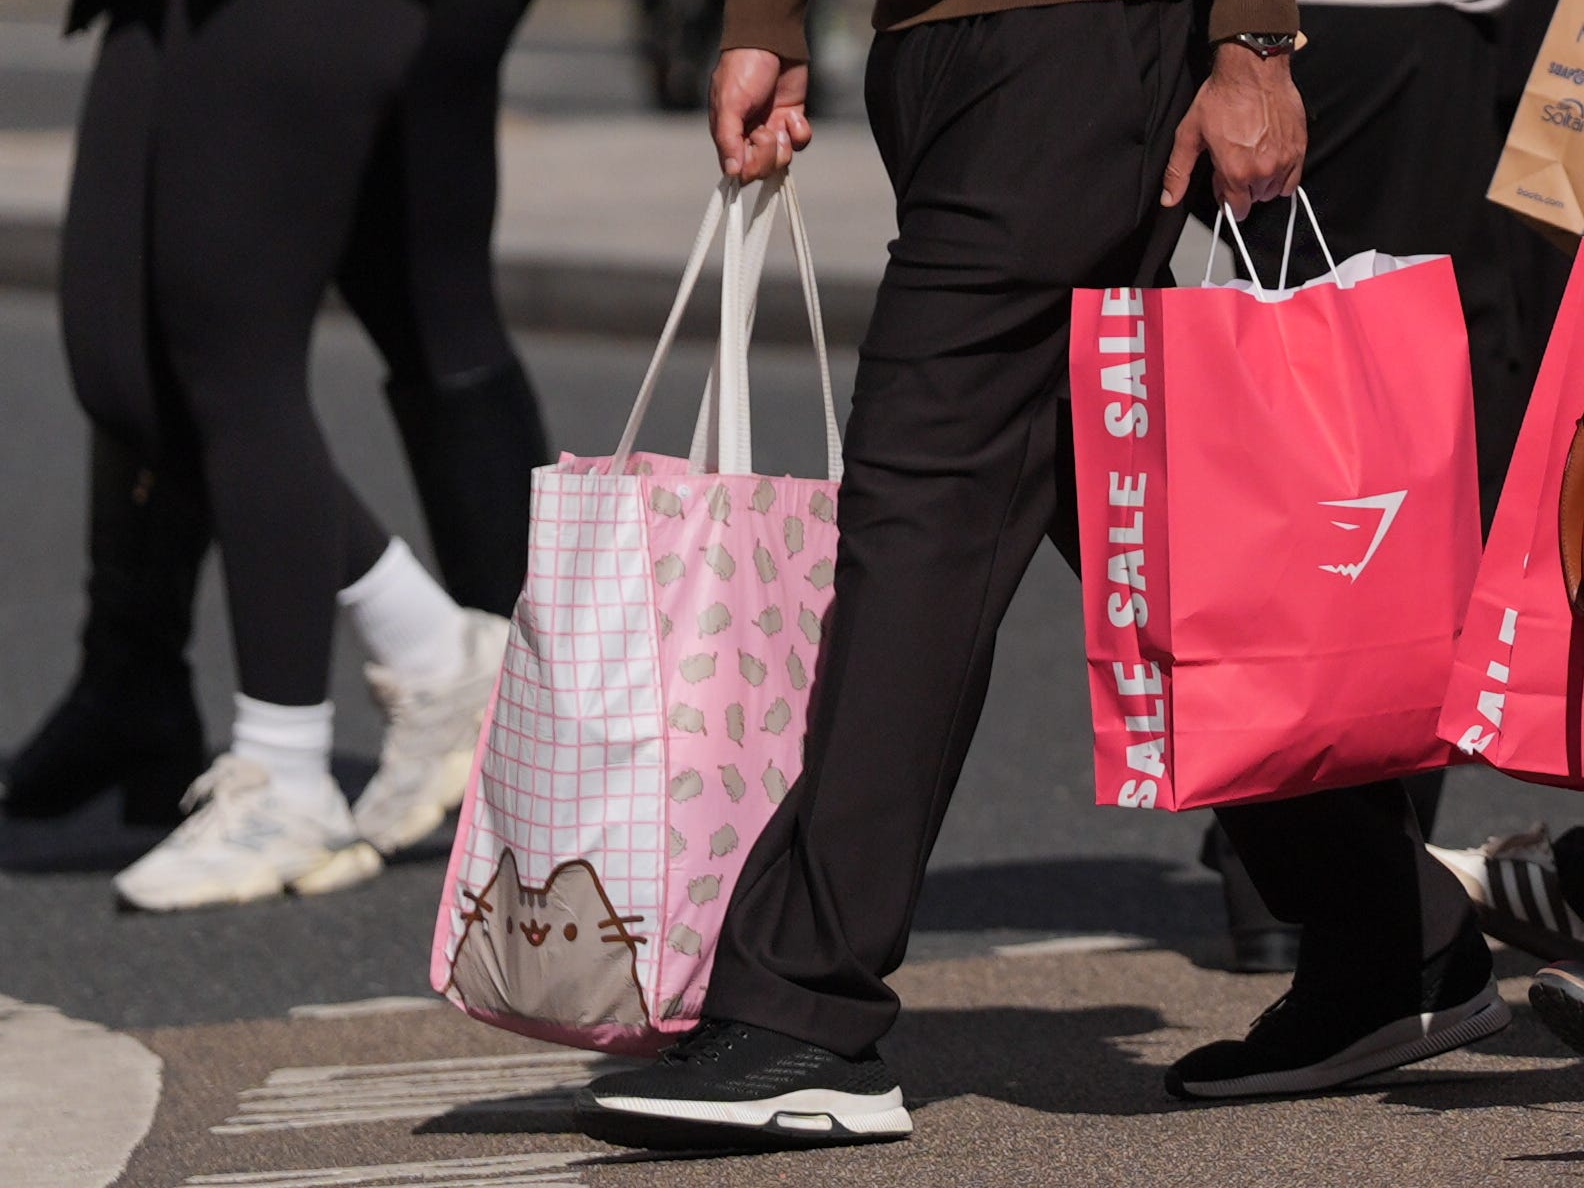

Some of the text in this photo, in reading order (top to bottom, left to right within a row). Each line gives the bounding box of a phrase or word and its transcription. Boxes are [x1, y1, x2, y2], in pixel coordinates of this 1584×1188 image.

[1099, 287, 1165, 810] SALE SALE SALE
